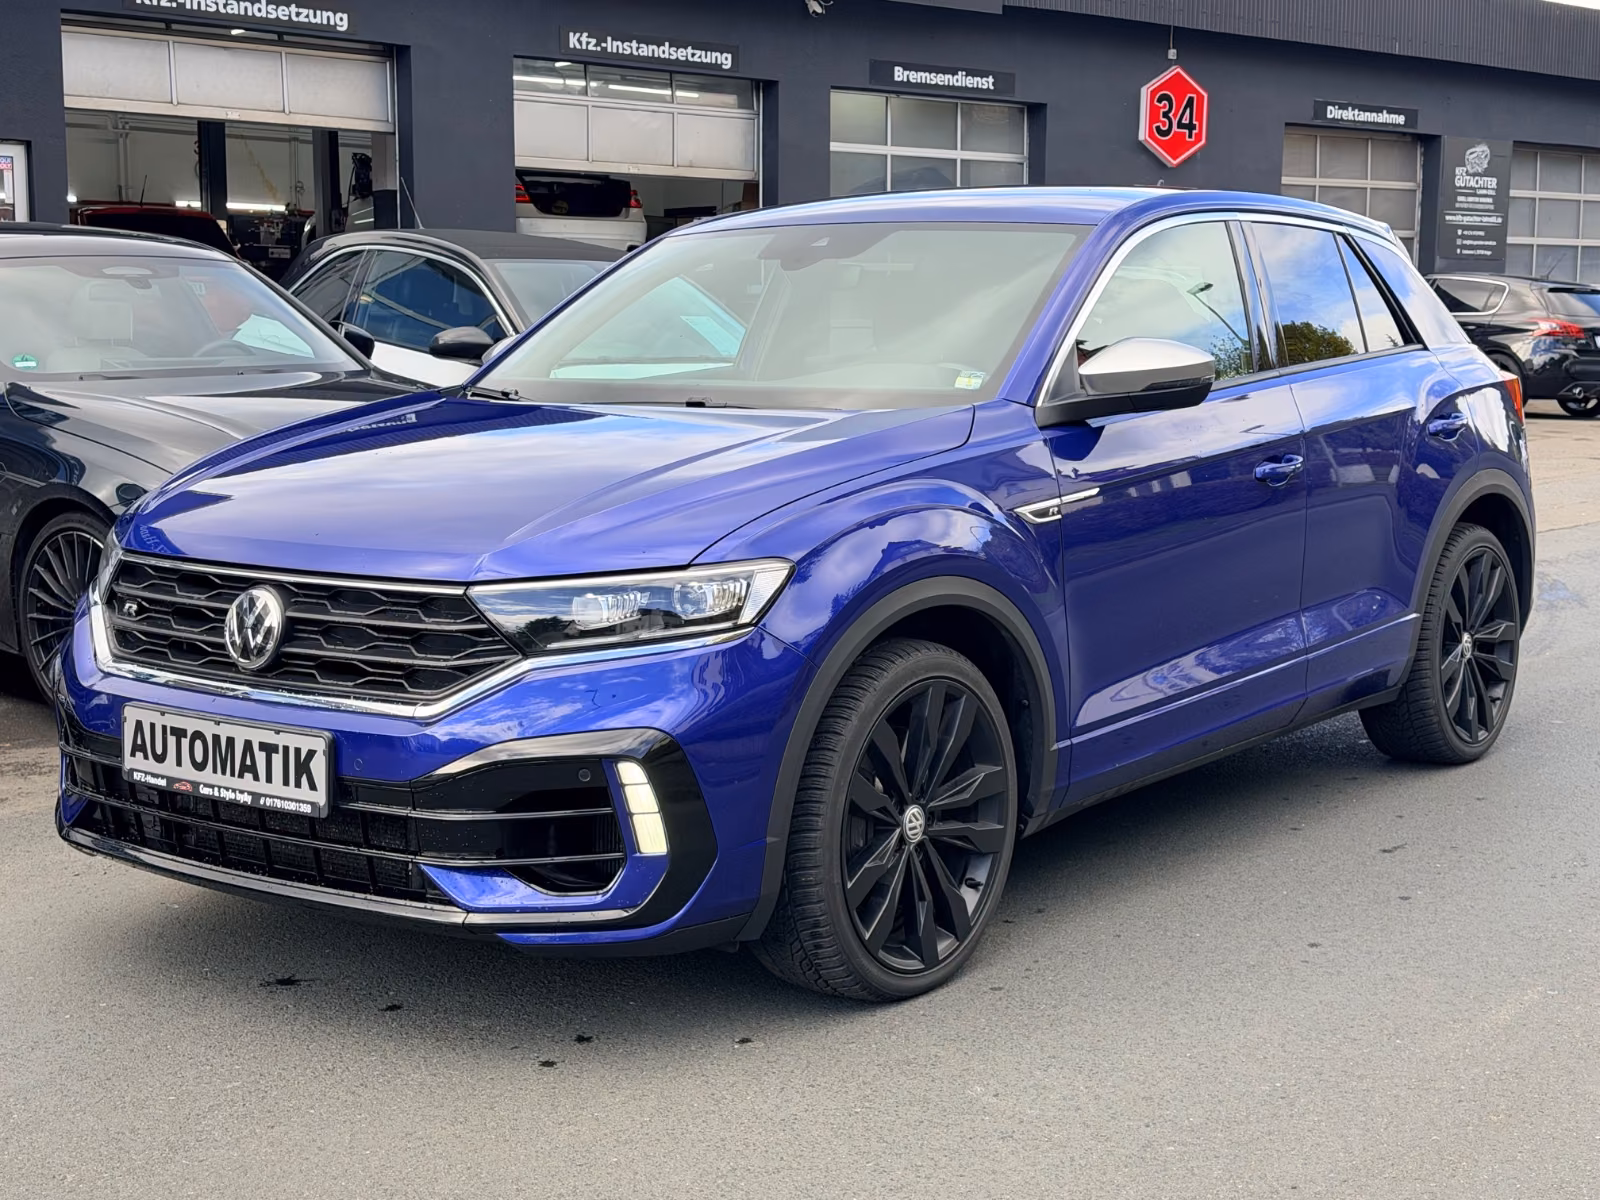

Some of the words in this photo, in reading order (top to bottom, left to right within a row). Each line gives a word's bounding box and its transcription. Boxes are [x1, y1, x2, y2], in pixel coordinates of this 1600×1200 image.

[135, 0, 349, 32] .-nstandsetzung
[568, 31, 732, 70] Kfz.-Instandsetzung
[893, 65, 995, 90] Bremsendienst
[1152, 90, 1199, 142] 34
[1326, 105, 1405, 125] Direktannahme
[1454, 175, 1498, 189] GUTACHTER
[130, 719, 318, 792] AUTOMATIK
[133, 771, 167, 787] KFZ-Handel
